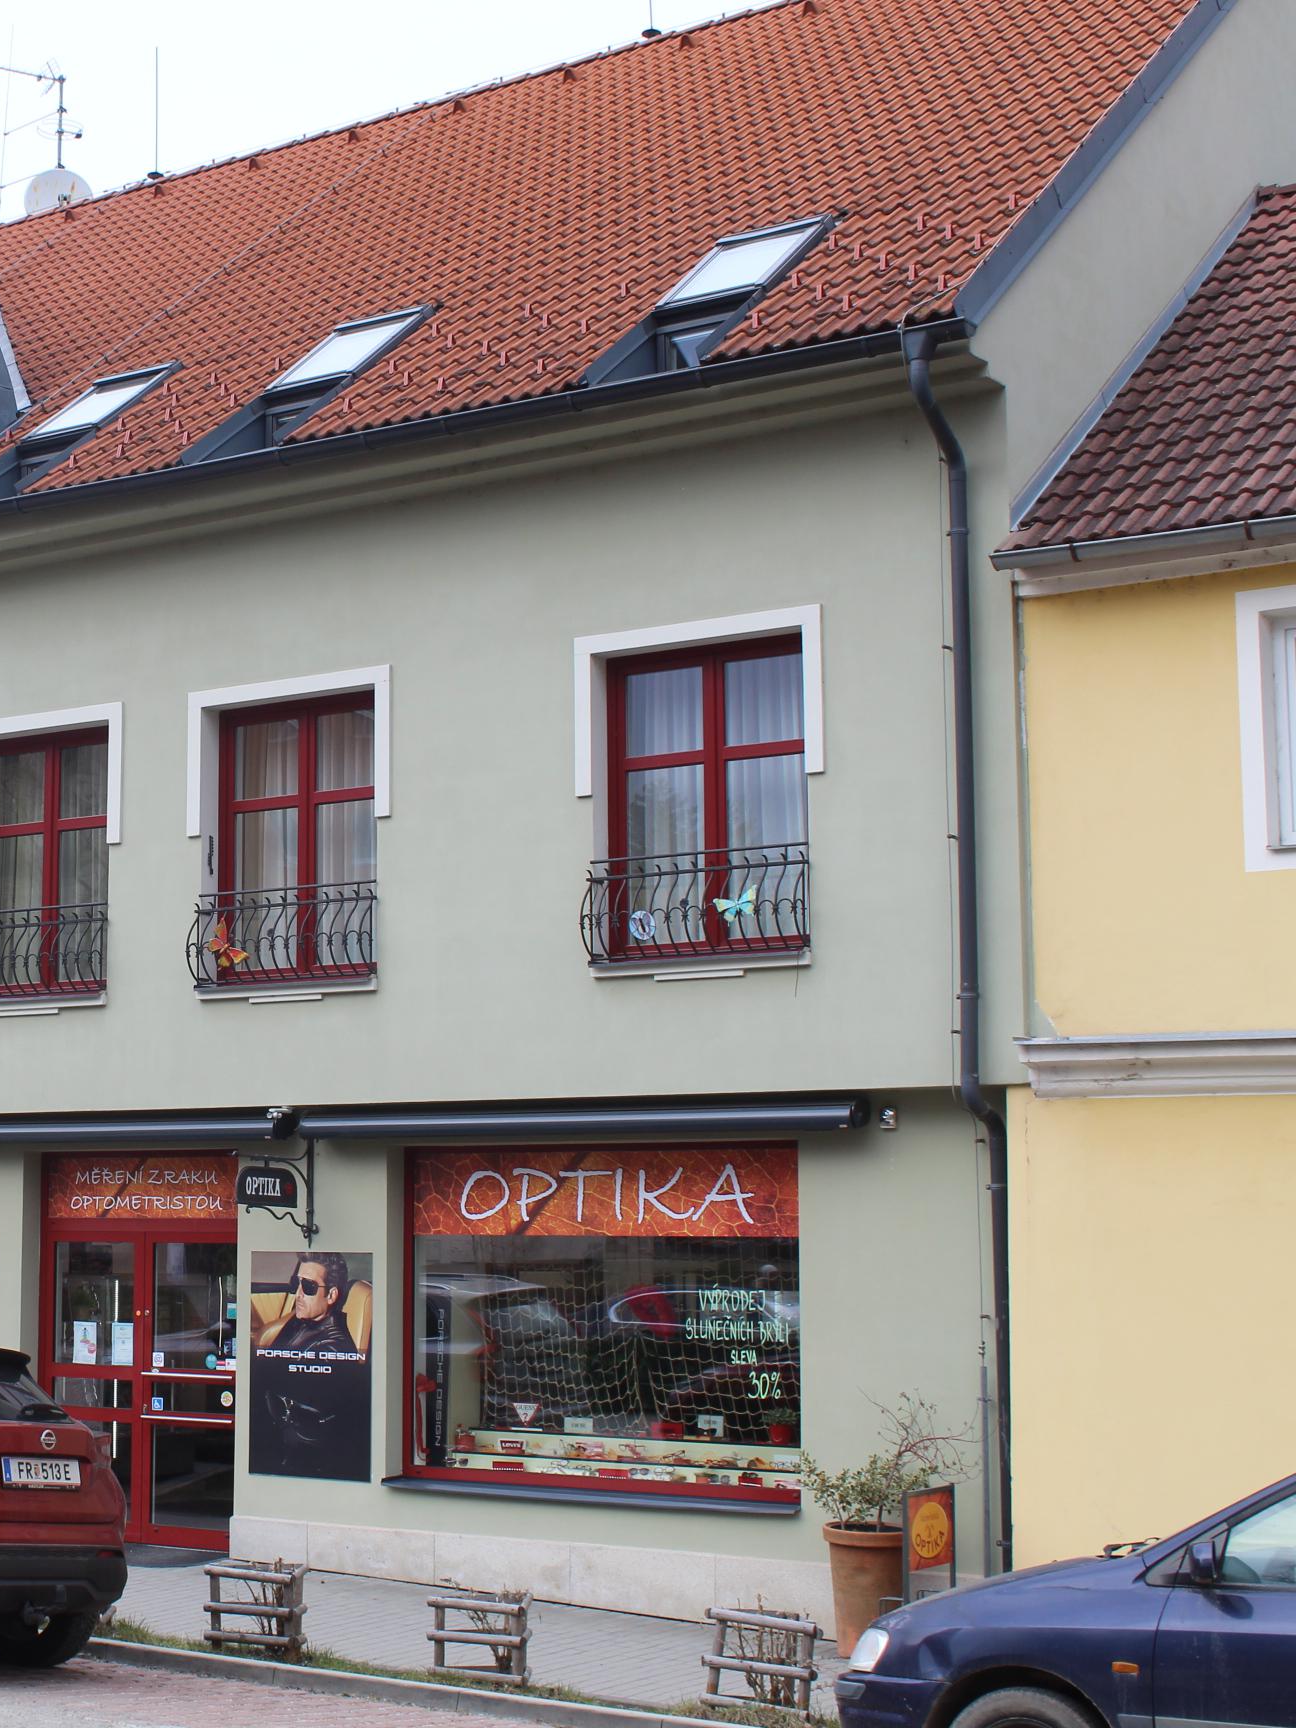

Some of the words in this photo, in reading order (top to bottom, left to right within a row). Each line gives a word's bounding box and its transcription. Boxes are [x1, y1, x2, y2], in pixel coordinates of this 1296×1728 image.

[75, 1165, 145, 1186] MĚŘENÍ
[147, 1169, 219, 1186] ZRAKU
[245, 1176, 282, 1197] OPTIKA
[460, 1163, 755, 1225] OPTIKA
[70, 1195, 224, 1211] OPTOMETRISTOU
[698, 1283, 766, 1312] VÝPRODEJ
[256, 1349, 316, 1360] PORSCHE
[319, 1351, 366, 1361] DESIGN
[436, 1308, 445, 1384] PORSCHE
[730, 1349, 758, 1366] SLEVA
[288, 1364, 332, 1374] STUDIO
[748, 1371, 781, 1400] 30%
[434, 1388, 443, 1446] DESIGN
[17, 1461, 34, 1480] FR
[41, 1463, 62, 1481] 513
[63, 1463, 71, 1481] E
[914, 1530, 945, 1554] OPTIKA
